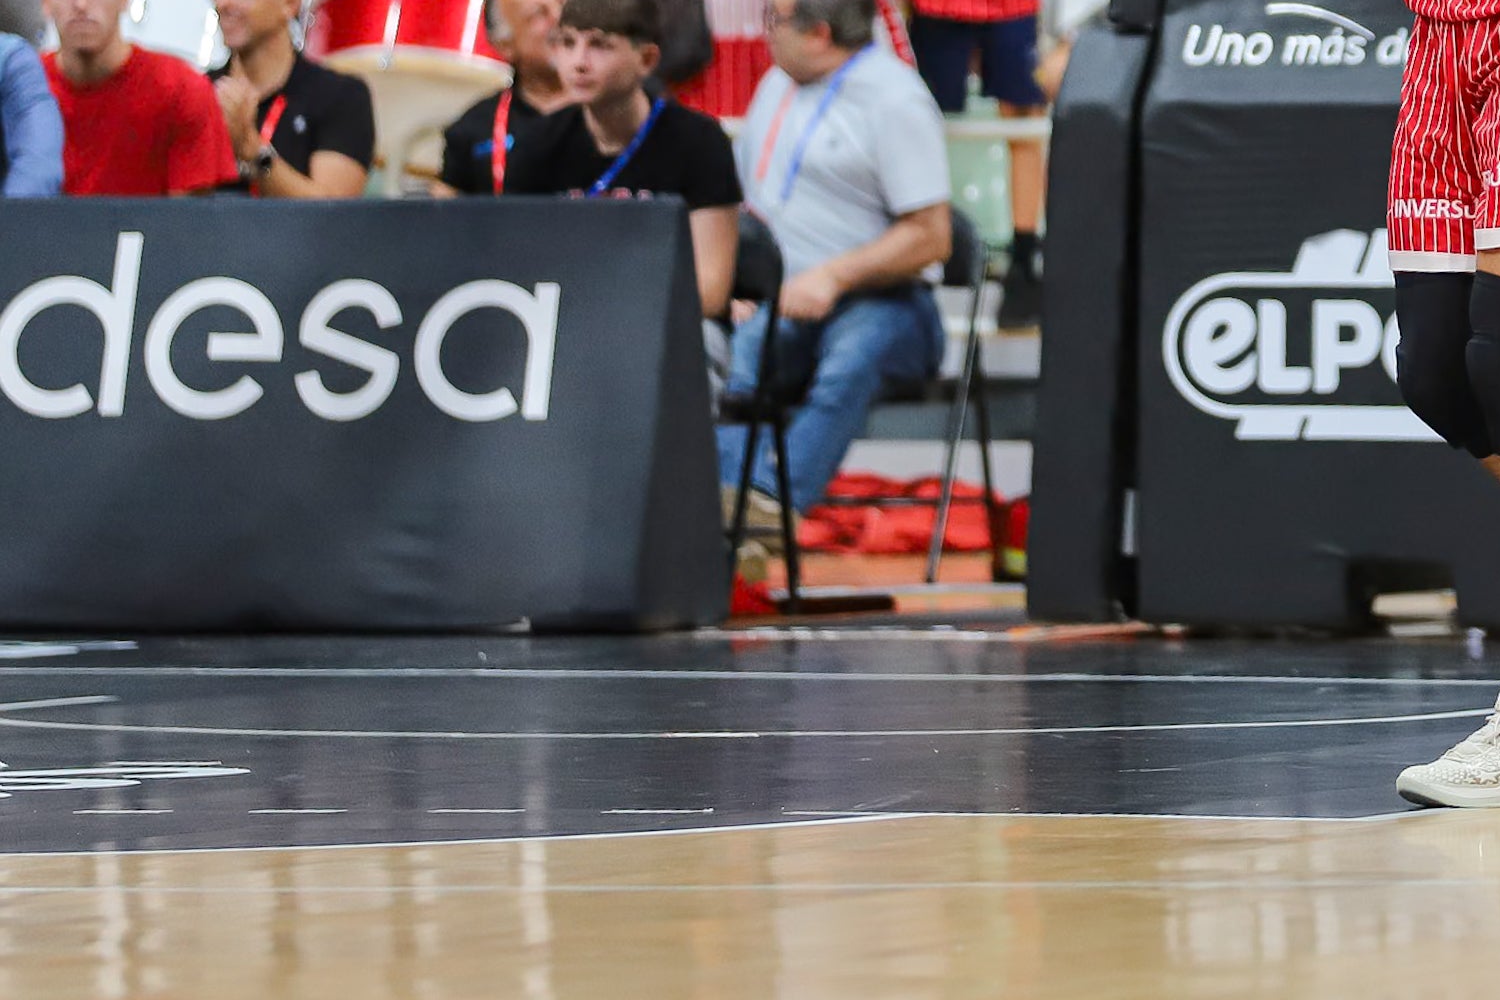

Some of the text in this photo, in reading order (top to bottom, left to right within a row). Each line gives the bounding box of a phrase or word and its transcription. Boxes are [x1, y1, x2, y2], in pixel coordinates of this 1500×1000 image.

[1182, 23, 1274, 67] Uno
[1281, 25, 1368, 67] más
[0, 231, 561, 422] desa
